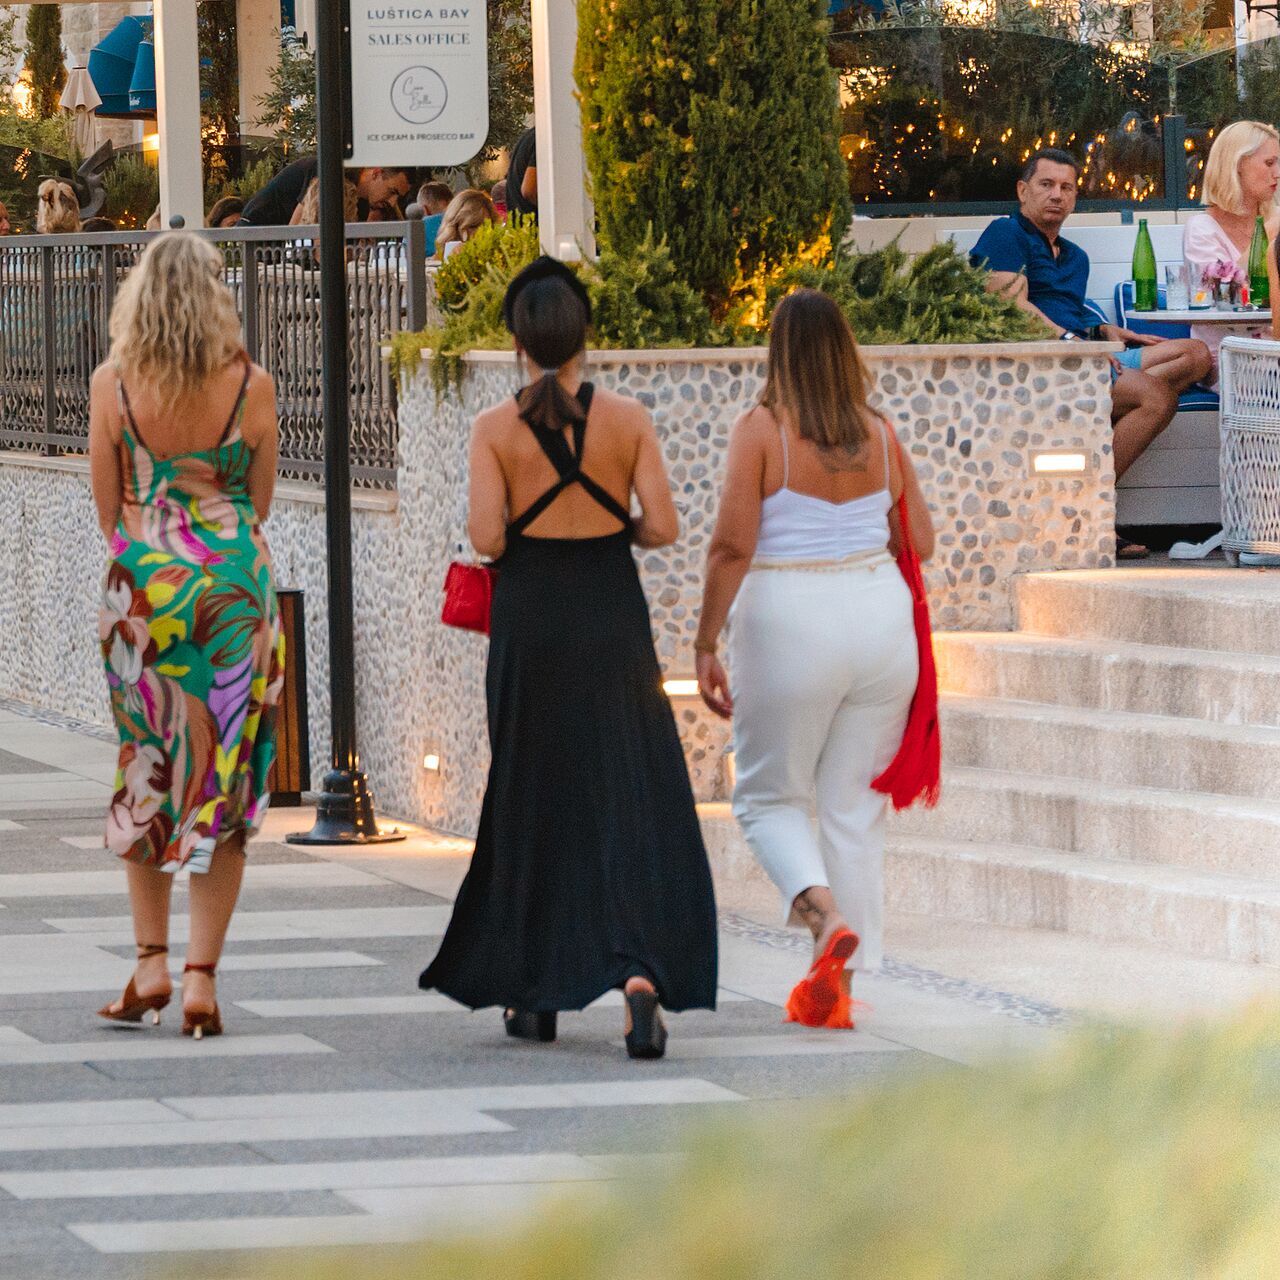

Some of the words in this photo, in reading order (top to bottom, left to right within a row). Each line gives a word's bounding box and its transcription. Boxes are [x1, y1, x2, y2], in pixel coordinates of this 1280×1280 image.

[367, 7, 434, 19] LUŠTICA
[440, 9, 470, 19] BAY
[367, 33, 413, 46] SALES
[416, 33, 471, 45] OFFICE
